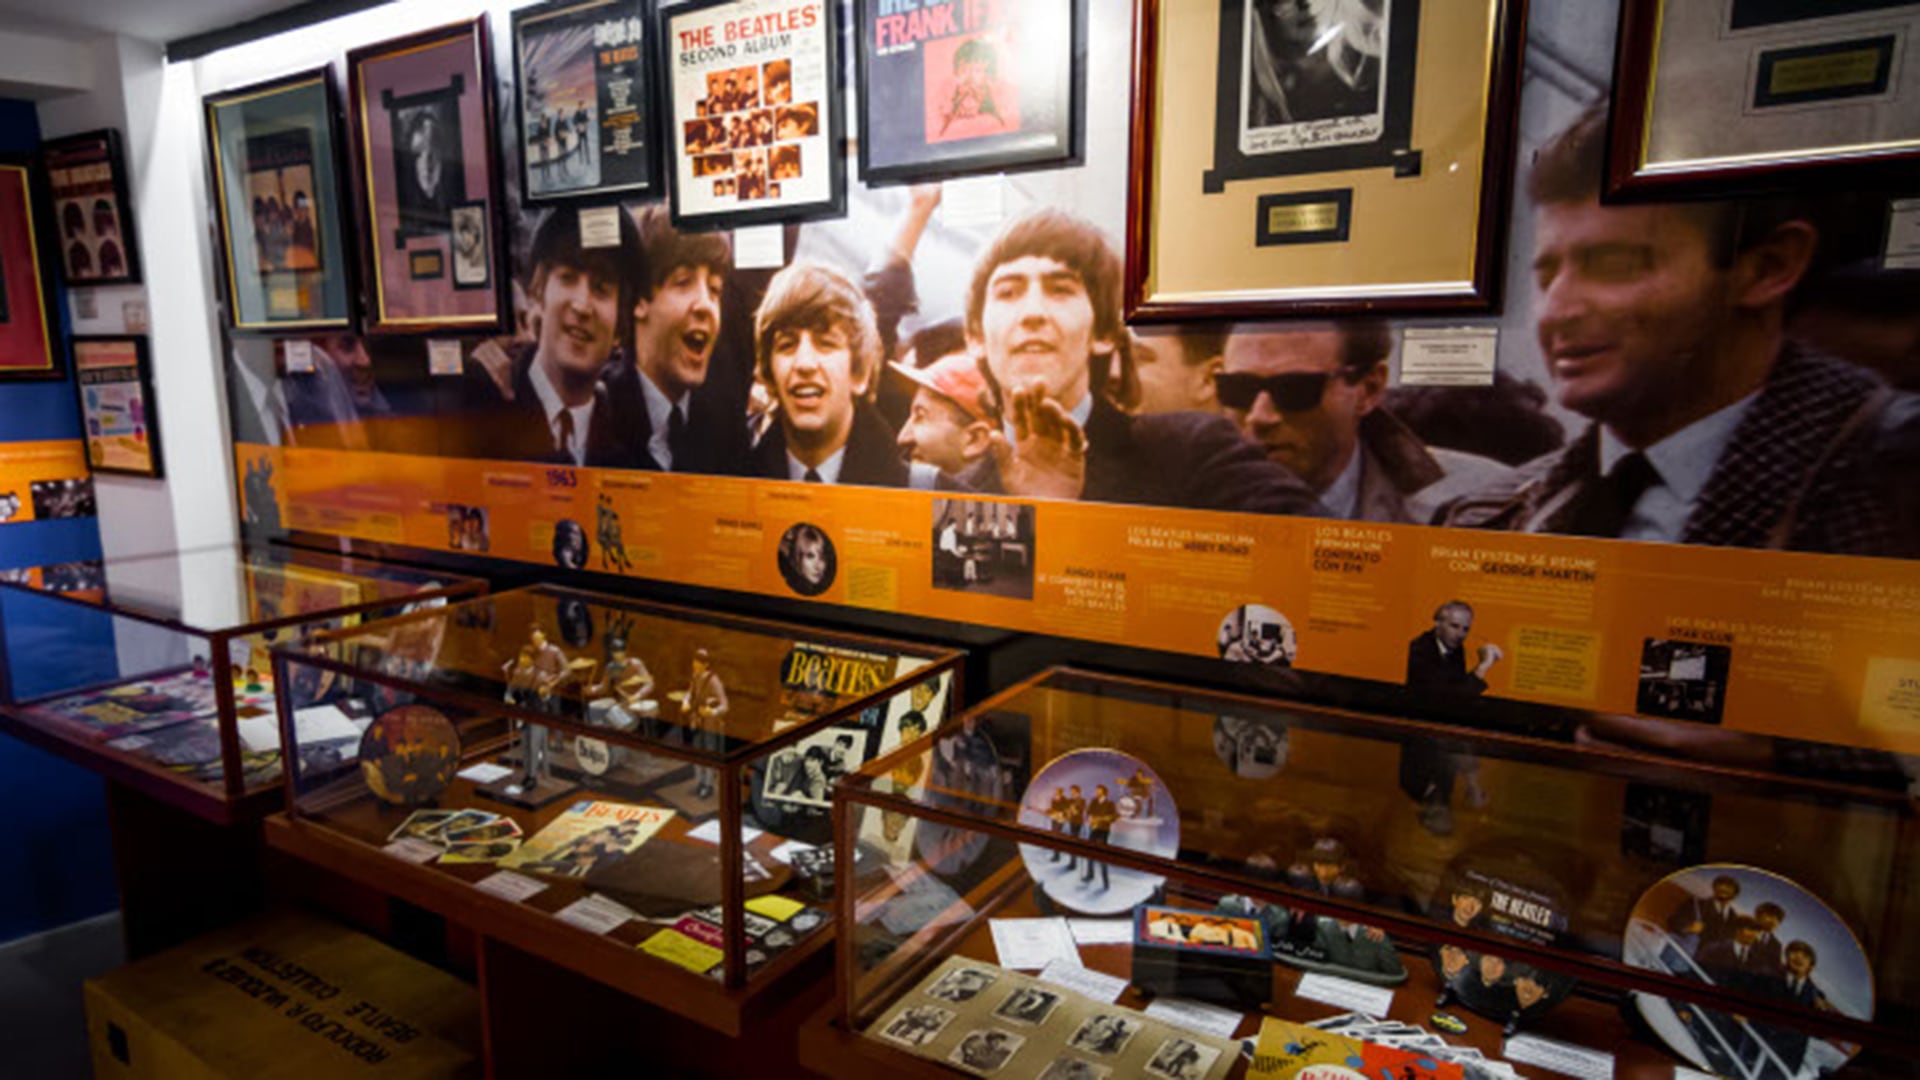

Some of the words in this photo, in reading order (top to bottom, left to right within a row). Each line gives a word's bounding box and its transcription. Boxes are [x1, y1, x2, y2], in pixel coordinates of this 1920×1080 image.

[875, 4, 959, 49] FRANK
[679, 25, 714, 50] THE
[680, 44, 737, 66] SECOND
[744, 34, 792, 53] ALBUM
[546, 469, 577, 488] 1963
[1315, 526, 1339, 538] LOS
[1343, 527, 1392, 542] BEATLES
[1314, 548, 1381, 564] CONTRATO
[1314, 559, 1340, 572] CON
[1430, 546, 1470, 560] BRIAN
[1473, 548, 1527, 564] EPSTEIN
[1530, 553, 1547, 567] SE
[1449, 560, 1480, 572] CON
[1481, 562, 1537, 577] GEORGE
[1541, 567, 1596, 582] MARTIN
